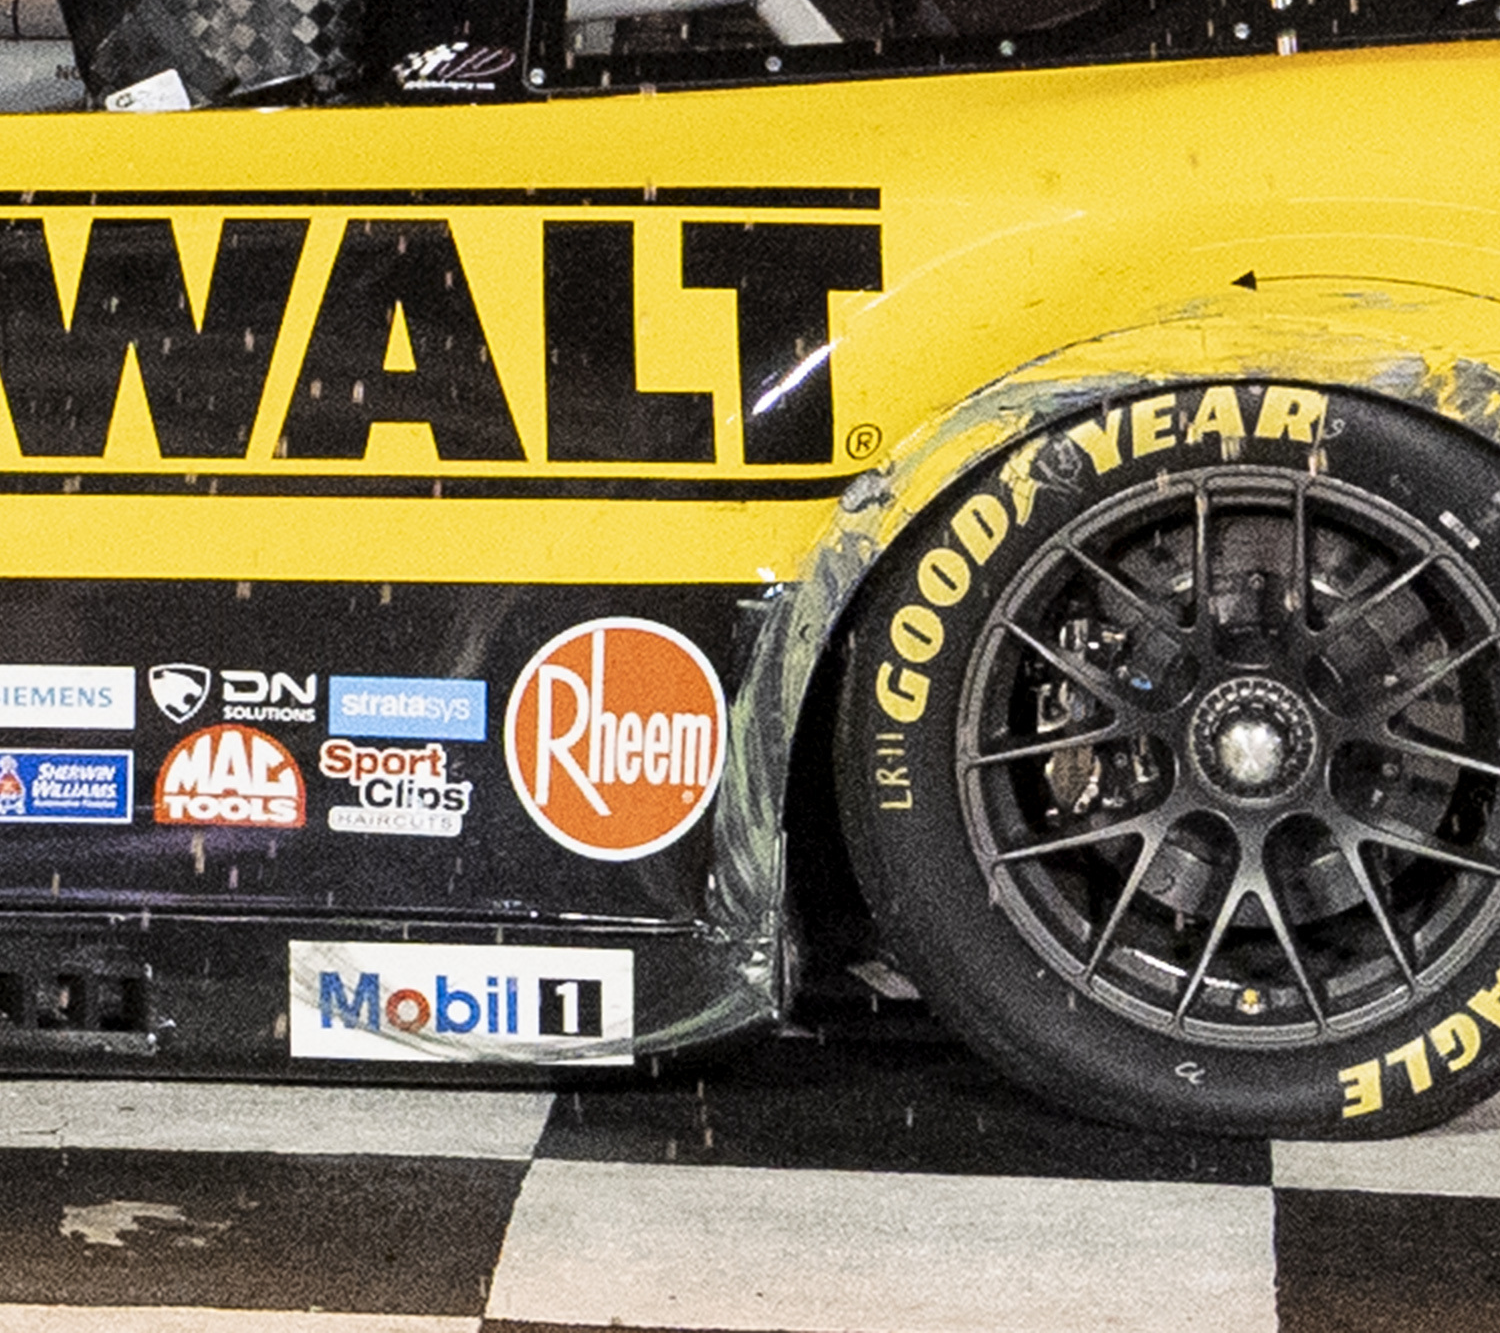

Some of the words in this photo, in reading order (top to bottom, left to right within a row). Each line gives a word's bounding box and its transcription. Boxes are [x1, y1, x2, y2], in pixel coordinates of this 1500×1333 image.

[876, 383, 1332, 723] GOODYEAR
[220, 670, 317, 704] DN
[222, 705, 316, 723] SOLUTIONS
[341, 690, 471, 724] stratasys
[536, 630, 712, 816] Rheem
[38, 762, 116, 782] SHERWIN
[162, 730, 299, 796] MAC
[322, 743, 446, 779] Sport
[162, 795, 298, 823] TOOLS
[361, 779, 467, 811] Clips
[337, 812, 454, 832] HAIRCUTS
[319, 971, 520, 1036] Mobil
